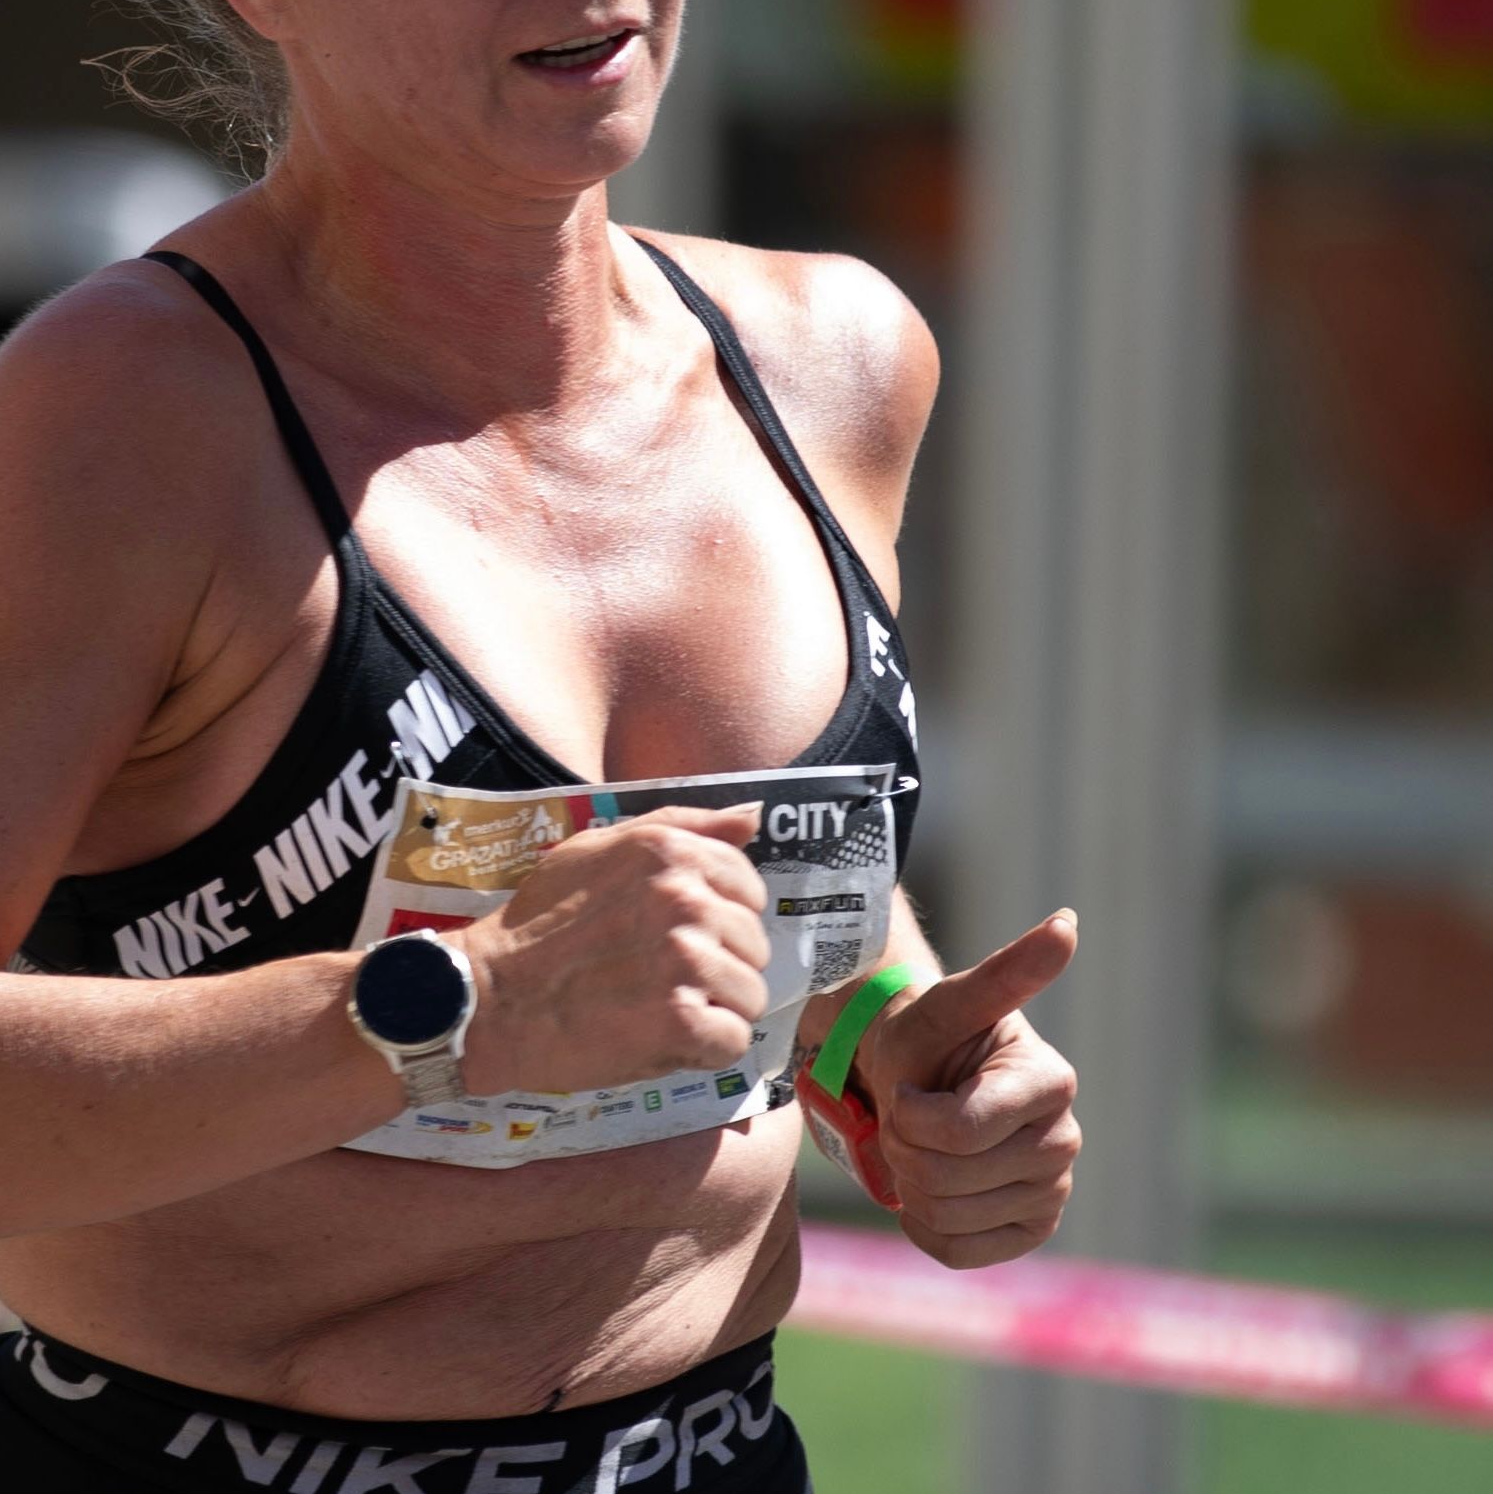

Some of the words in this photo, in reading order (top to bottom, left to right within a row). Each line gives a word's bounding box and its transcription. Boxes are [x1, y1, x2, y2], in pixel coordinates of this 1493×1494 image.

[113, 878, 251, 979] NIKE
[253, 749, 394, 919] NIKE
[387, 668, 477, 781] NI
[767, 800, 851, 843] CITY
